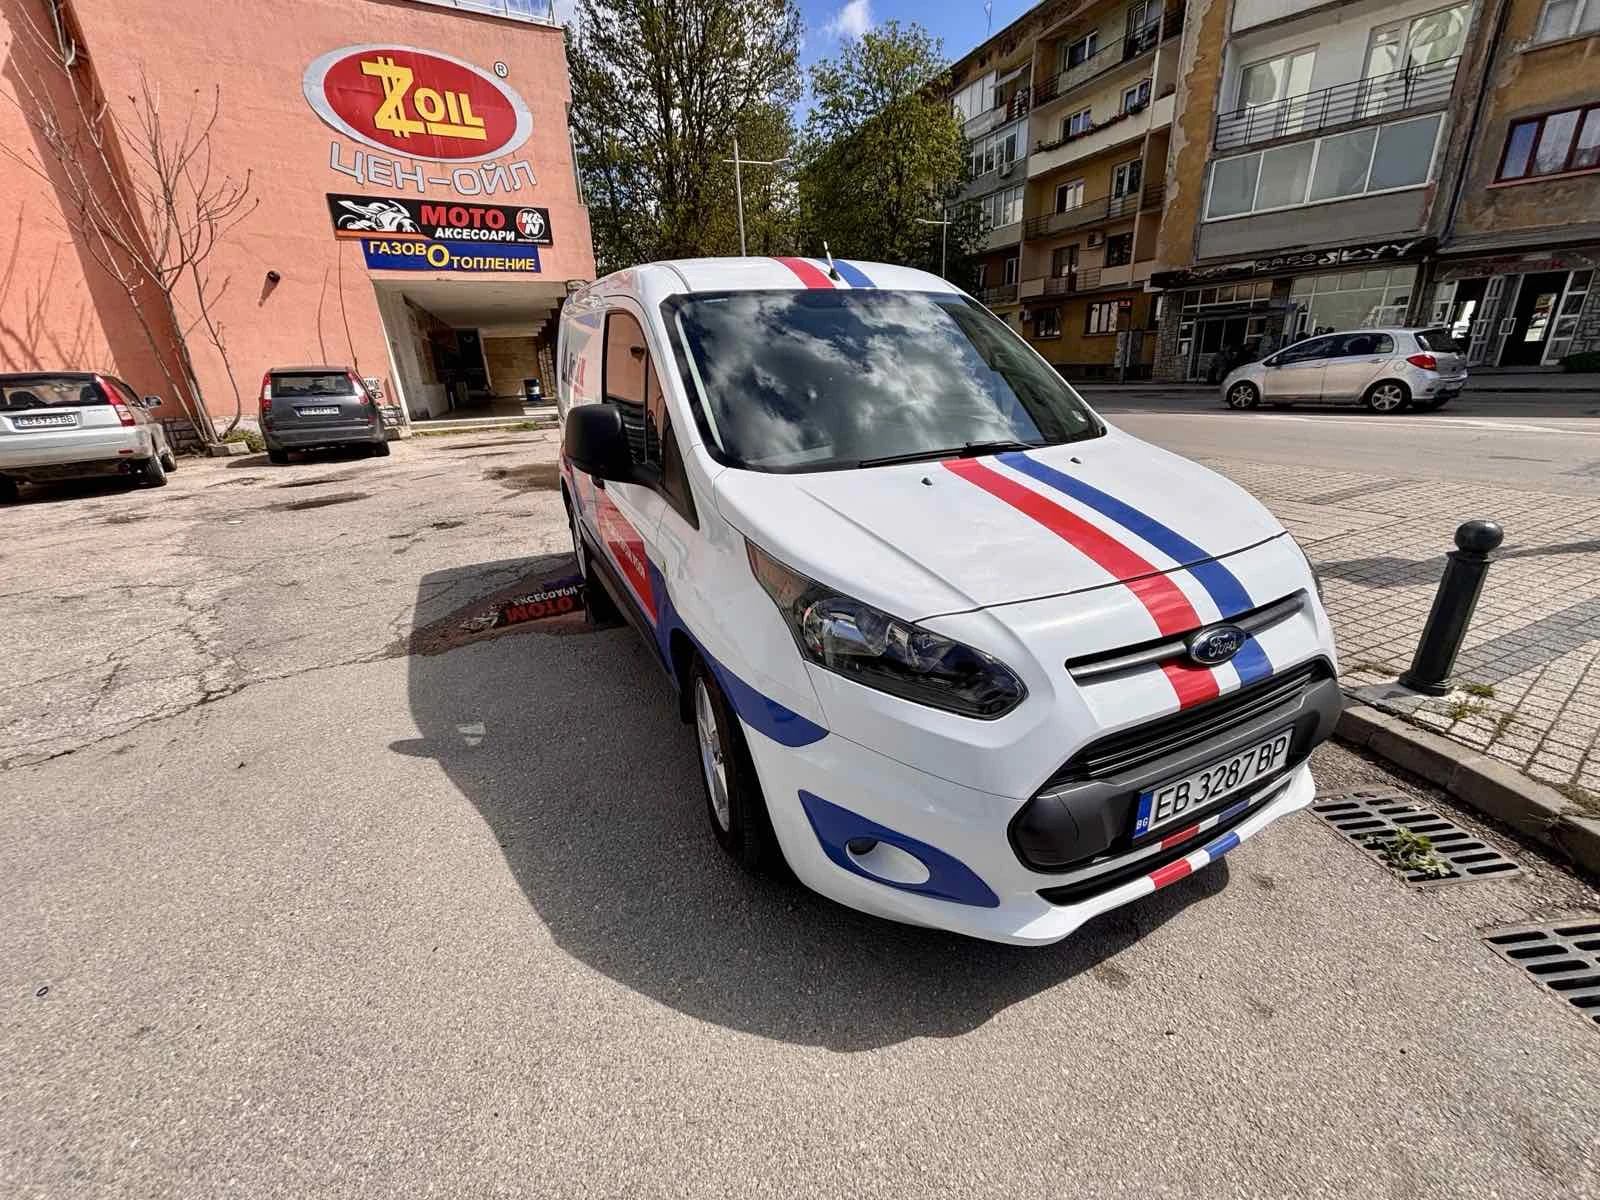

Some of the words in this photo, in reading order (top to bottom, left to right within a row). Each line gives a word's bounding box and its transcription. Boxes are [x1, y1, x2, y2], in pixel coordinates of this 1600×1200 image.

[330, 141, 537, 195] ЦЕН-ОЙЛ
[421, 205, 505, 229] МОТО
[434, 228, 515, 241] АКСЕСОАРИ
[1208, 633, 1237, 657] Ford
[1154, 781, 1190, 822] EB
[1194, 750, 1256, 803] 3287
[1256, 736, 1287, 775] BP
[1136, 817, 1149, 830] BG
